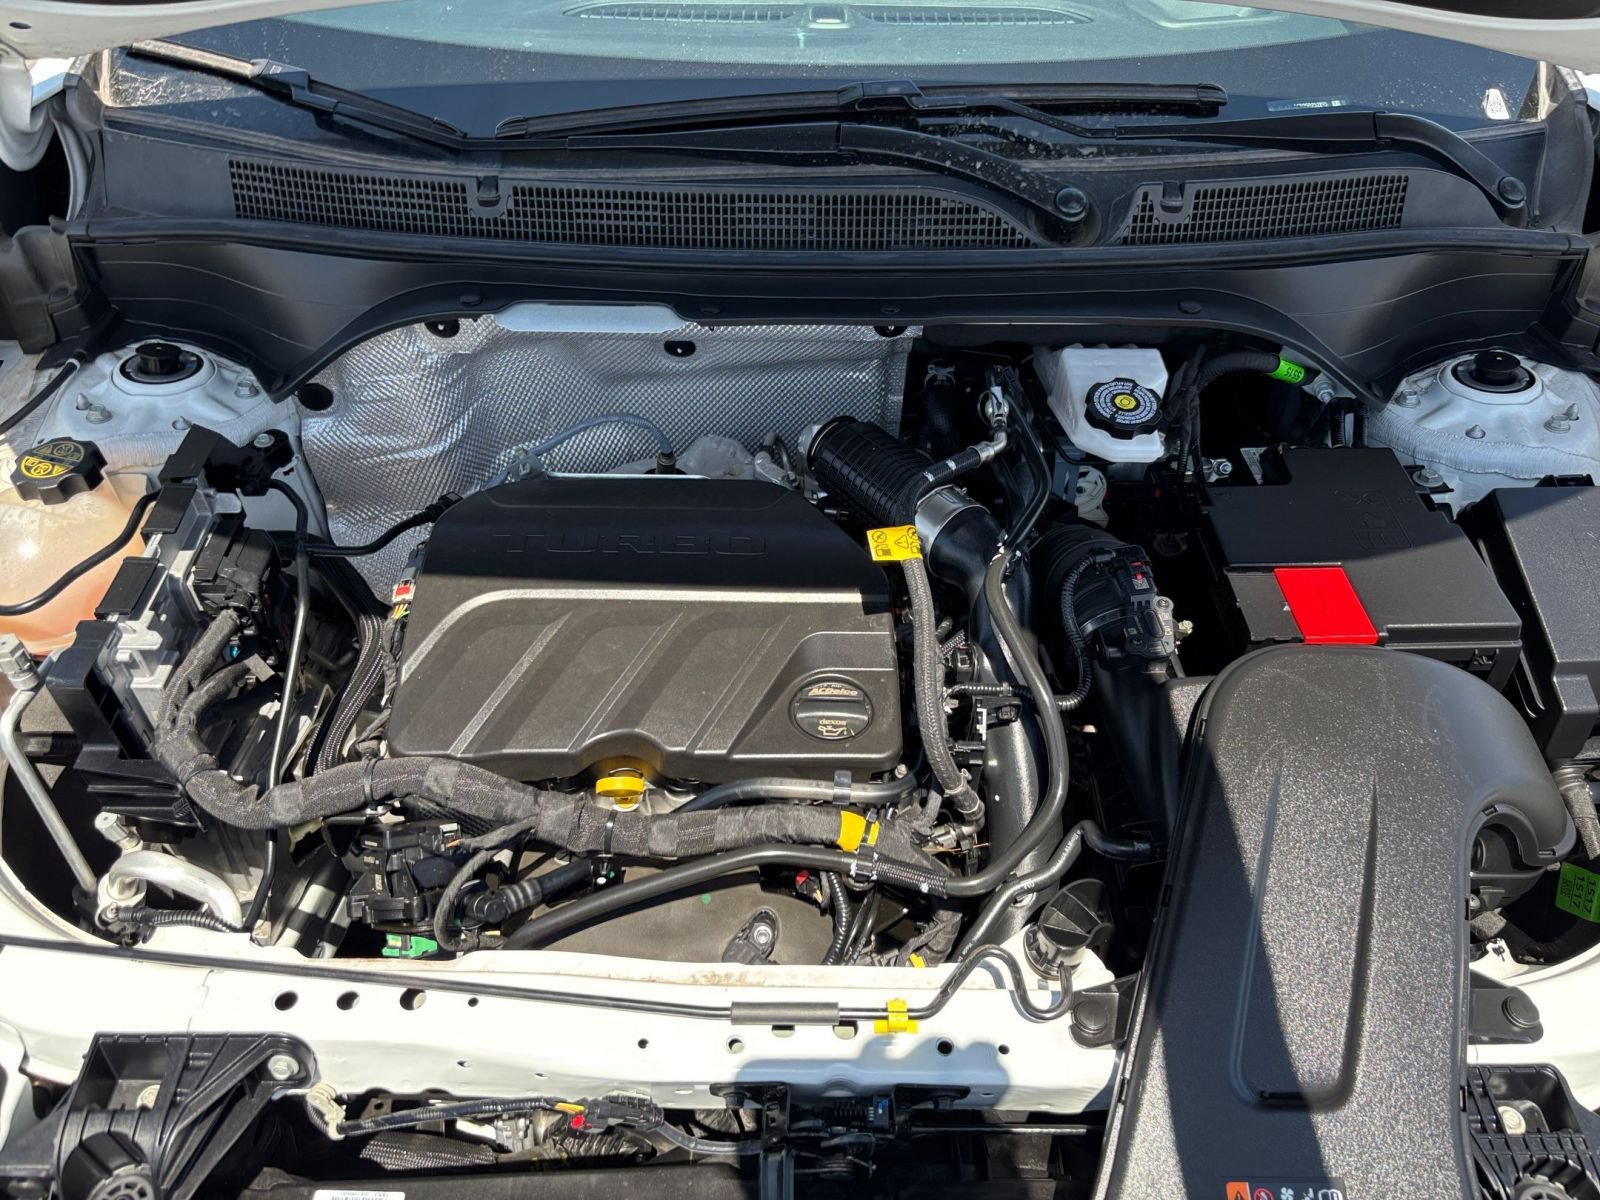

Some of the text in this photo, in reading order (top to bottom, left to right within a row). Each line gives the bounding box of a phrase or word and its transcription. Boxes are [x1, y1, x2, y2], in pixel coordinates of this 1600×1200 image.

[493, 533, 766, 557] TURBO
[808, 687, 858, 696] ACDelco
[819, 718, 847, 726] dexos
[1572, 875, 1586, 910] 1517
[1583, 880, 1597, 915] 1517
